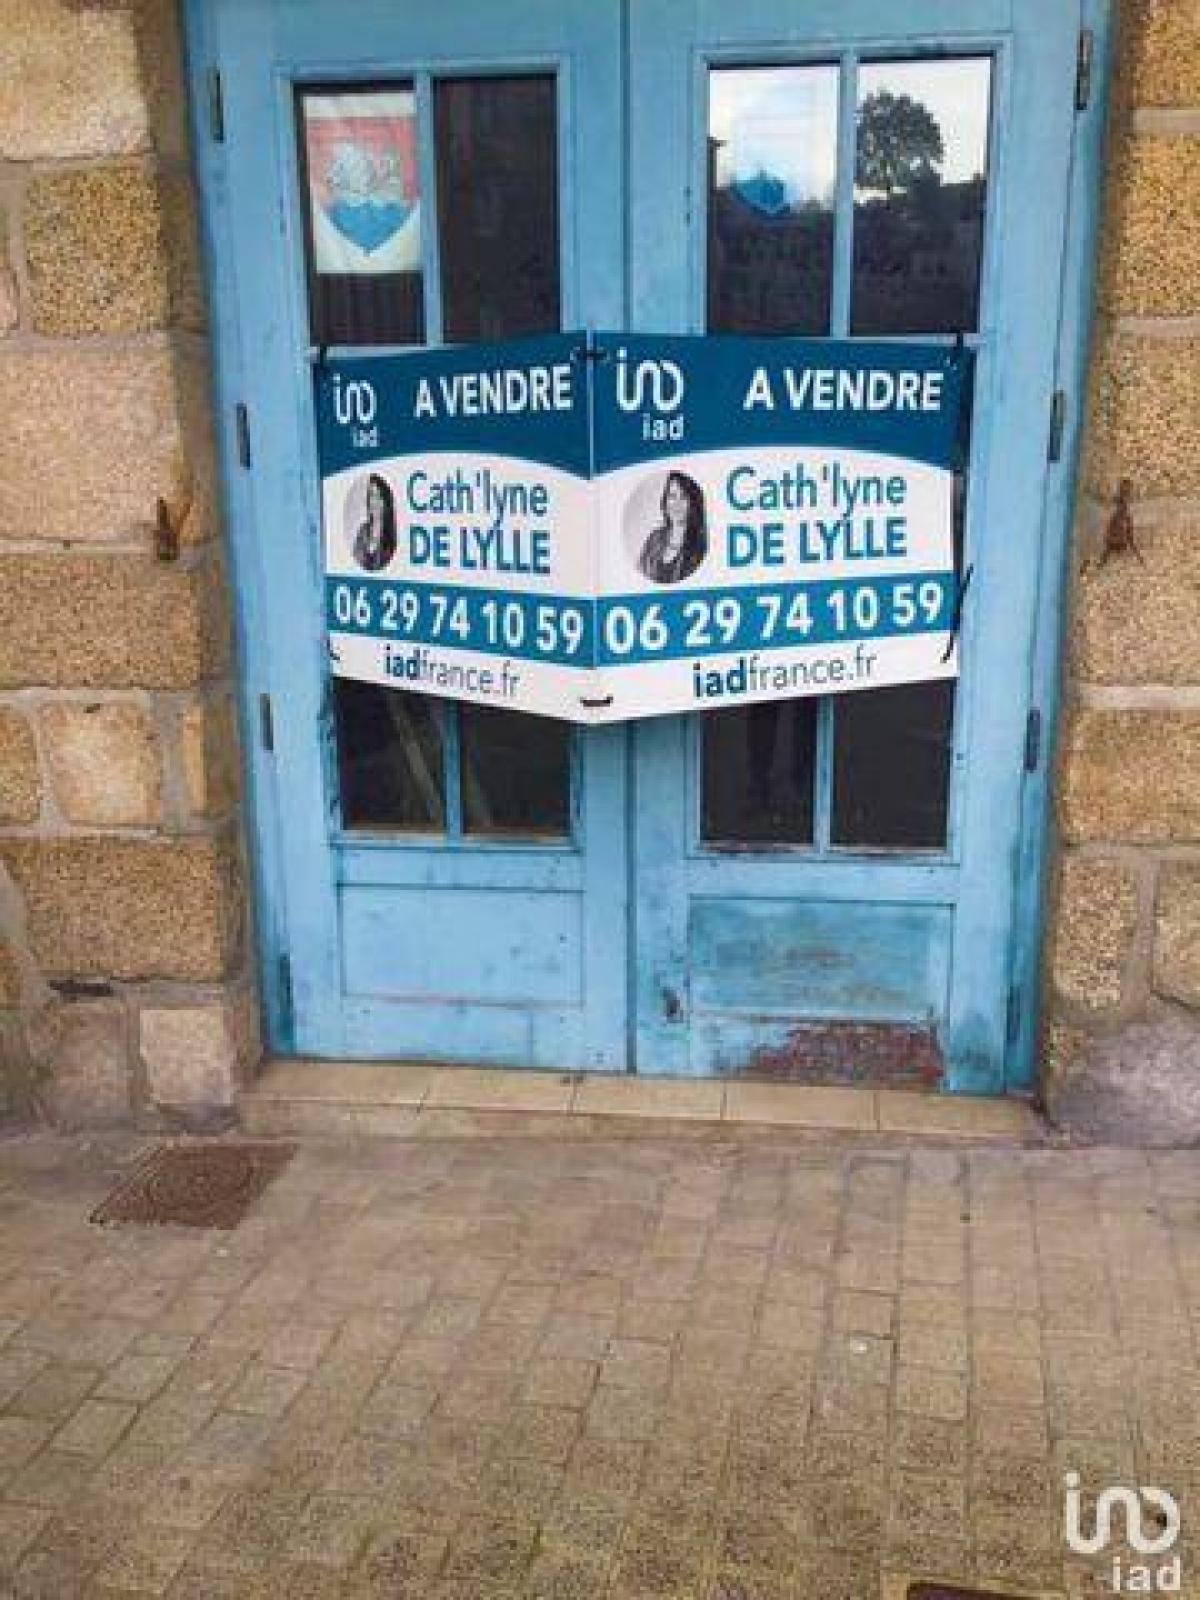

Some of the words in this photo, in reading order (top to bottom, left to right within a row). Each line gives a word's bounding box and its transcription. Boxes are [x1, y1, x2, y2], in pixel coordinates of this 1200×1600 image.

[414, 379, 437, 418] A
[439, 363, 572, 417] VENDRE
[743, 367, 775, 411] A
[782, 368, 944, 412] VENDRE
[642, 413, 684, 441] iad
[407, 467, 550, 522] Cath'lyne
[726, 464, 907, 522] Cath'lyne
[410, 525, 451, 566] DE
[458, 526, 551, 574] LYLLE
[727, 521, 785, 567] DE
[798, 515, 908, 564] LYLLE
[335, 584, 371, 627] 06
[379, 589, 419, 633] 29
[429, 595, 471, 641] 74
[480, 599, 524, 648] 10
[536, 605, 584, 655] 59
[605, 605, 669, 655] 06
[683, 599, 741, 647] 29
[756, 593, 814, 640] 74
[827, 586, 879, 631] 10
[893, 581, 943, 626] 59
[385, 645, 522, 697] iadfrance.fr
[692, 645, 877, 698] iadfrance.fr
